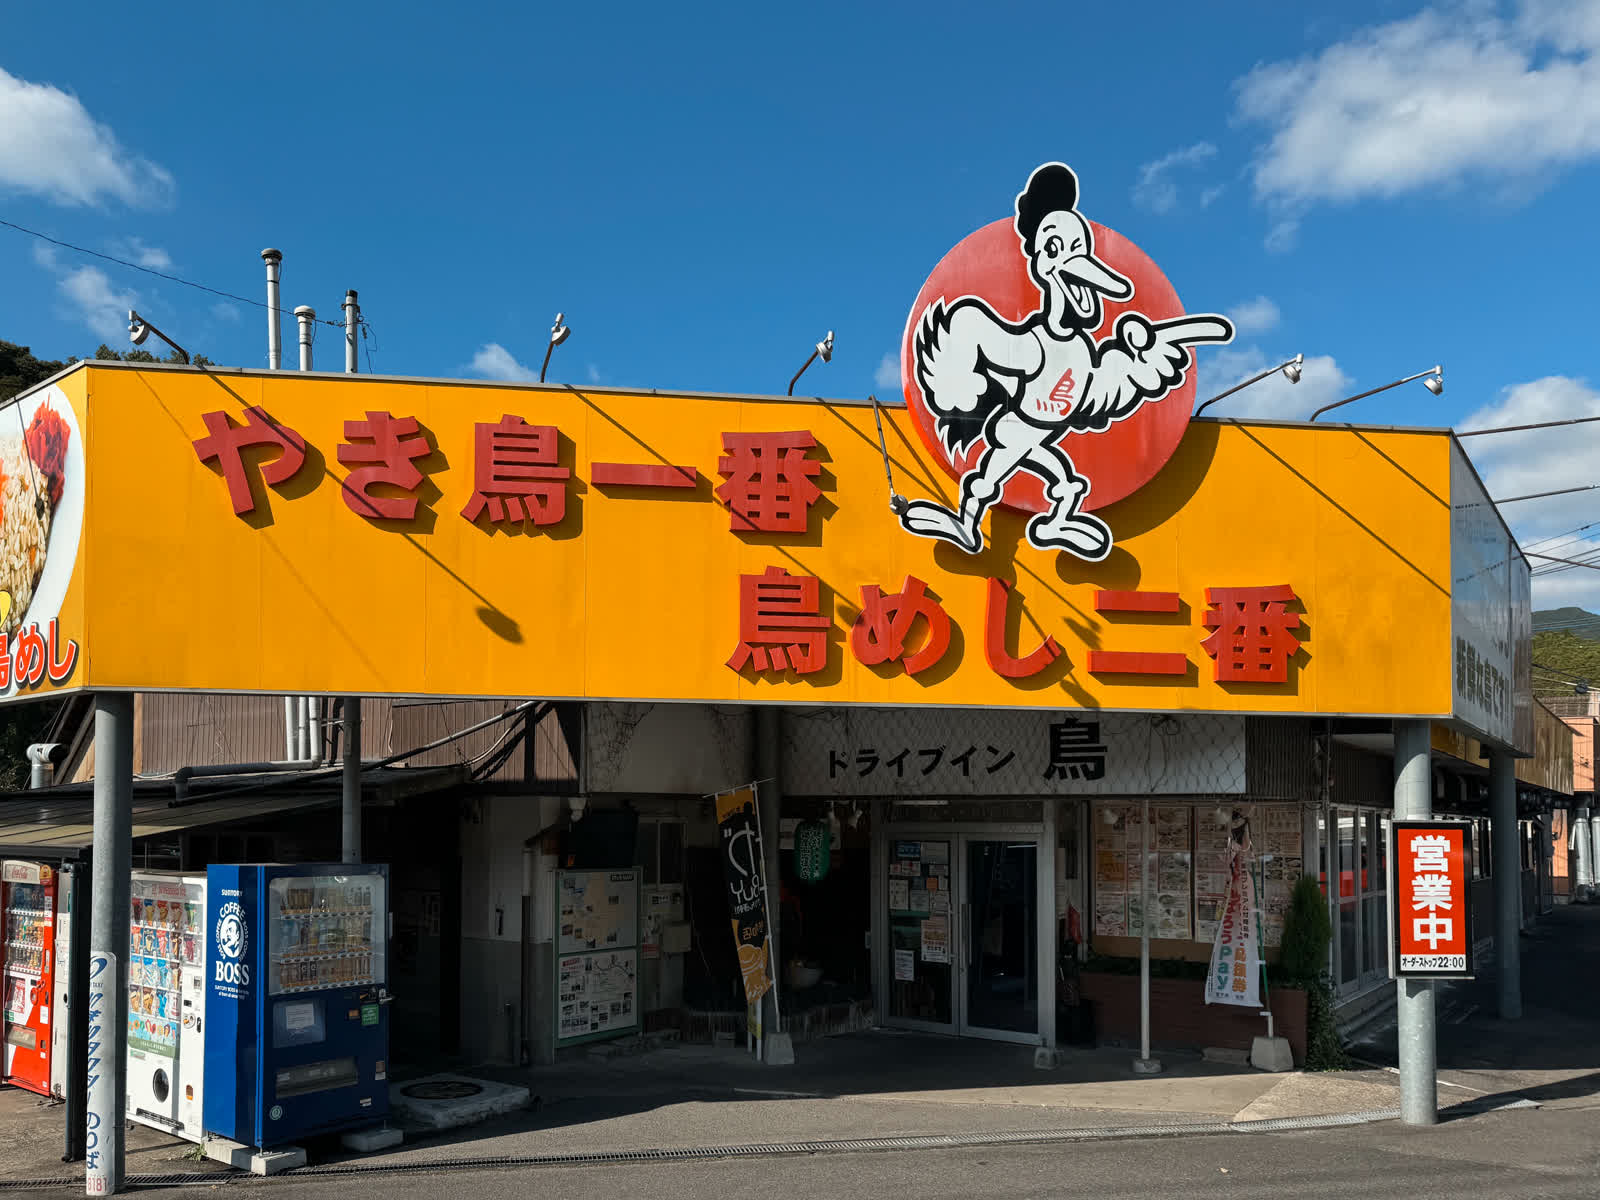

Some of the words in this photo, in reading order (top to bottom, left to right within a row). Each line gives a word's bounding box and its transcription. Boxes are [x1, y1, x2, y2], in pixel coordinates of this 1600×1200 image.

[193, 406, 822, 534] やき鳥一番
[726, 566, 1300, 684] 鳥めし二番
[828, 744, 1016, 779] ドライブイン
[1043, 717, 1108, 782] 鳥
[219, 901, 246, 921] COFFEE
[1410, 834, 1453, 950] 営業中
[215, 960, 250, 986] BOSS
